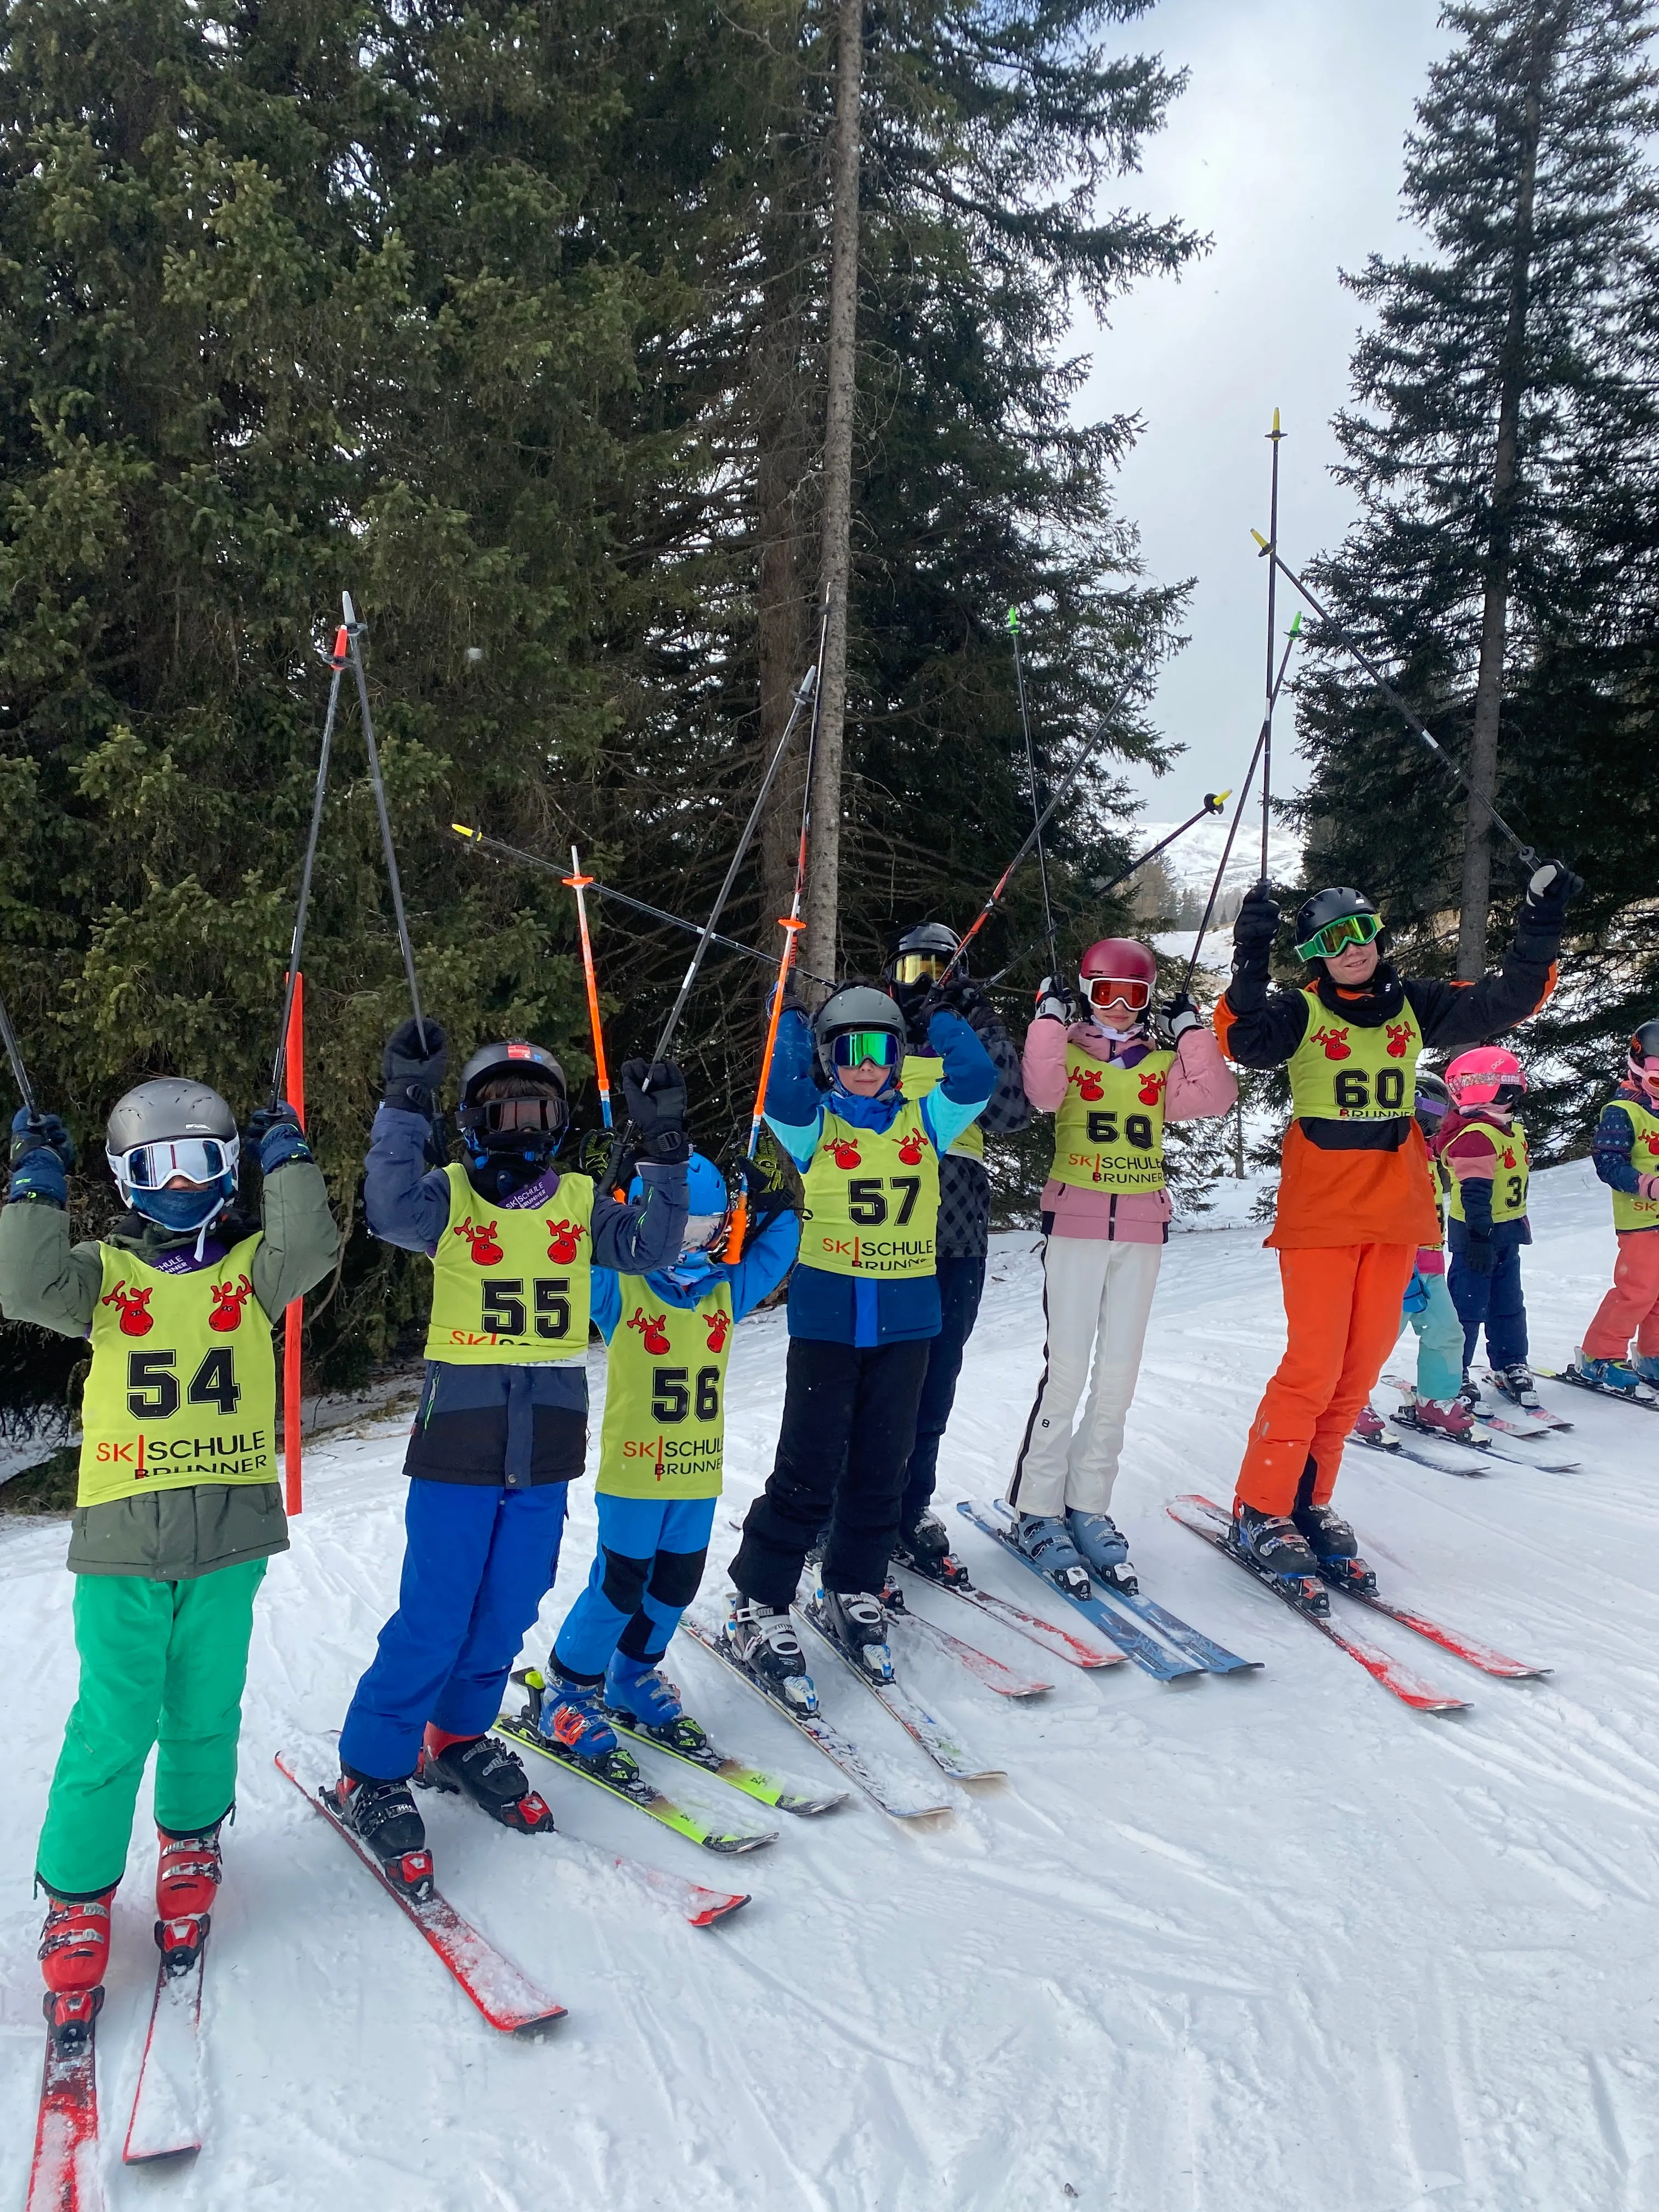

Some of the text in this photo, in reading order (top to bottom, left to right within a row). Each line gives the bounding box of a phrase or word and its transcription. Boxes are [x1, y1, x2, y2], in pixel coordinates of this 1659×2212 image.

[1333, 1066, 1405, 1109] 60
[848, 1175, 922, 1226] 57
[1092, 1172, 1163, 1183] BRUNNER
[481, 1278, 571, 1339] 55
[127, 1346, 241, 1420] 54
[651, 1365, 721, 1424] 56
[654, 1457, 723, 1475] BRUNNE
